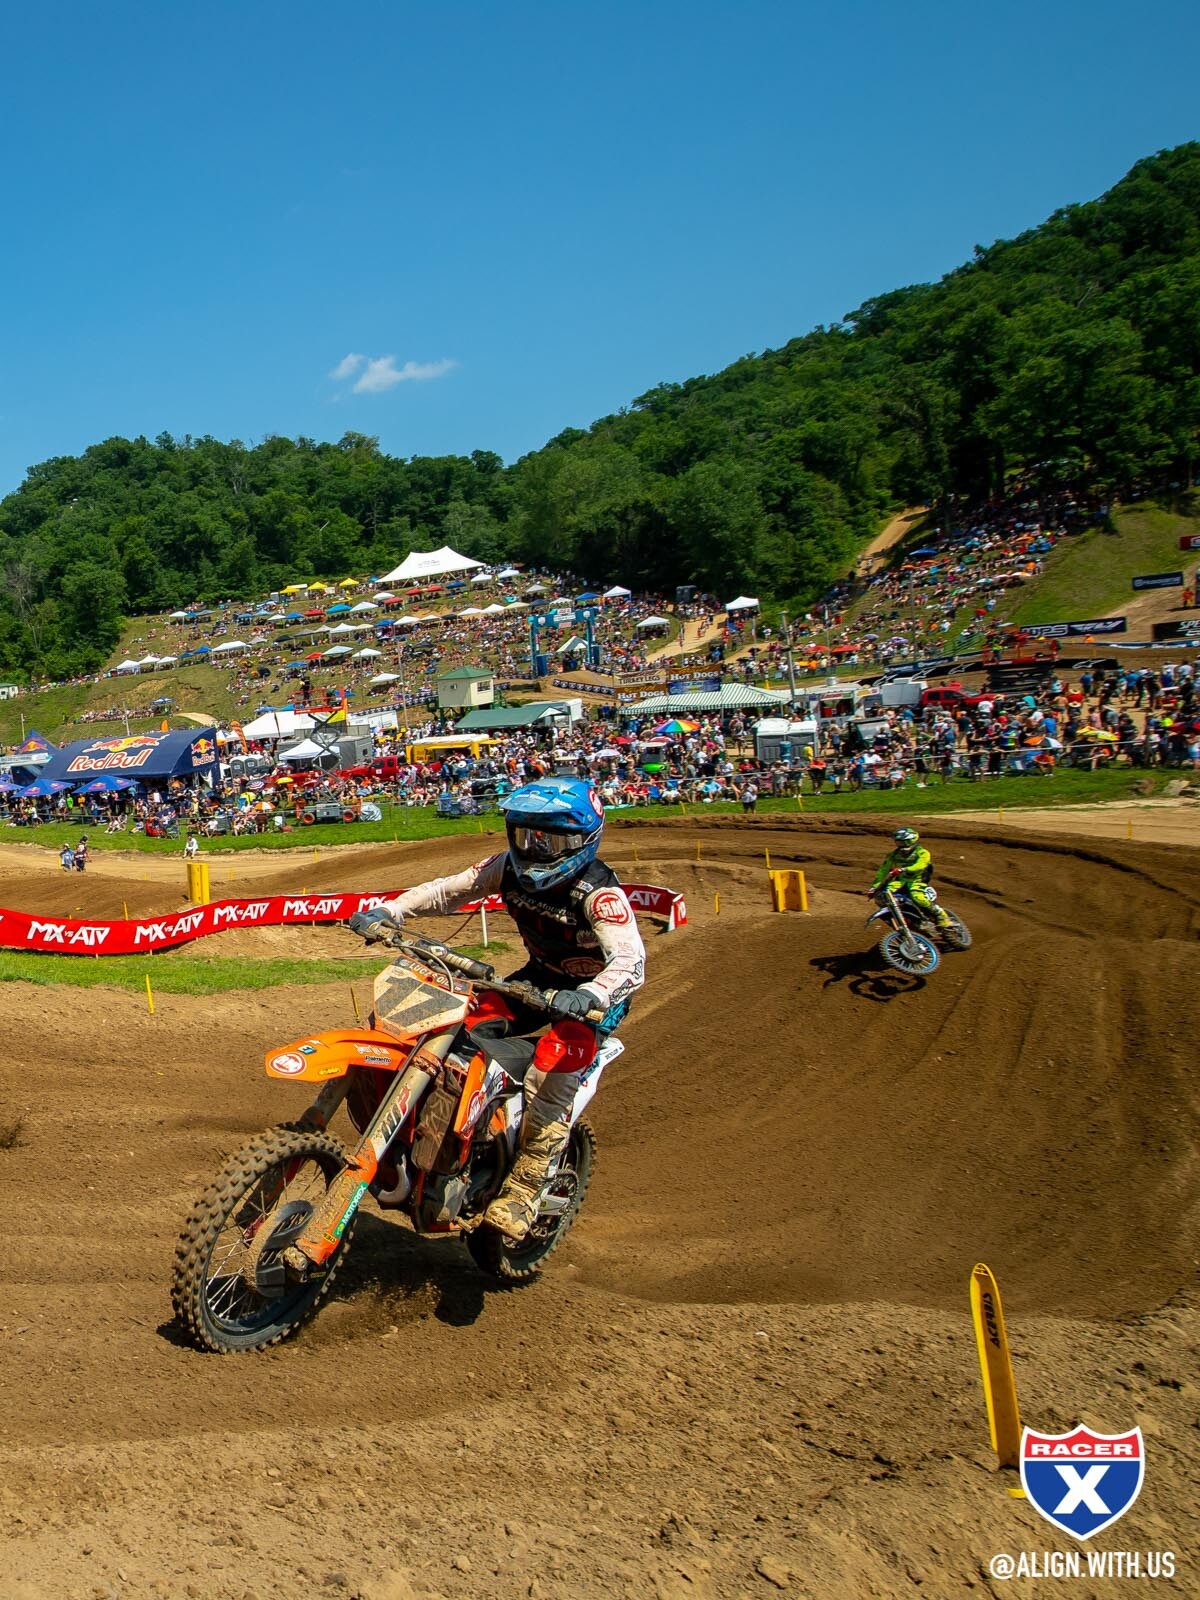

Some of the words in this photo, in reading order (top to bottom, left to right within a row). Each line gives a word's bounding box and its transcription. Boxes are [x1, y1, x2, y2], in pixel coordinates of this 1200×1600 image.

[282, 900, 310, 916] MX
[312, 899, 343, 914] ATV
[628, 890, 661, 906] ATV
[213, 905, 239, 925] MX
[241, 902, 270, 920] ATV
[27, 921, 66, 944] MX
[69, 926, 110, 946] ATV
[134, 921, 167, 944] MX
[171, 912, 204, 937] ATV
[342, 1185, 367, 1225] MOTOREX
[982, 1292, 1000, 1349] ACERBIS
